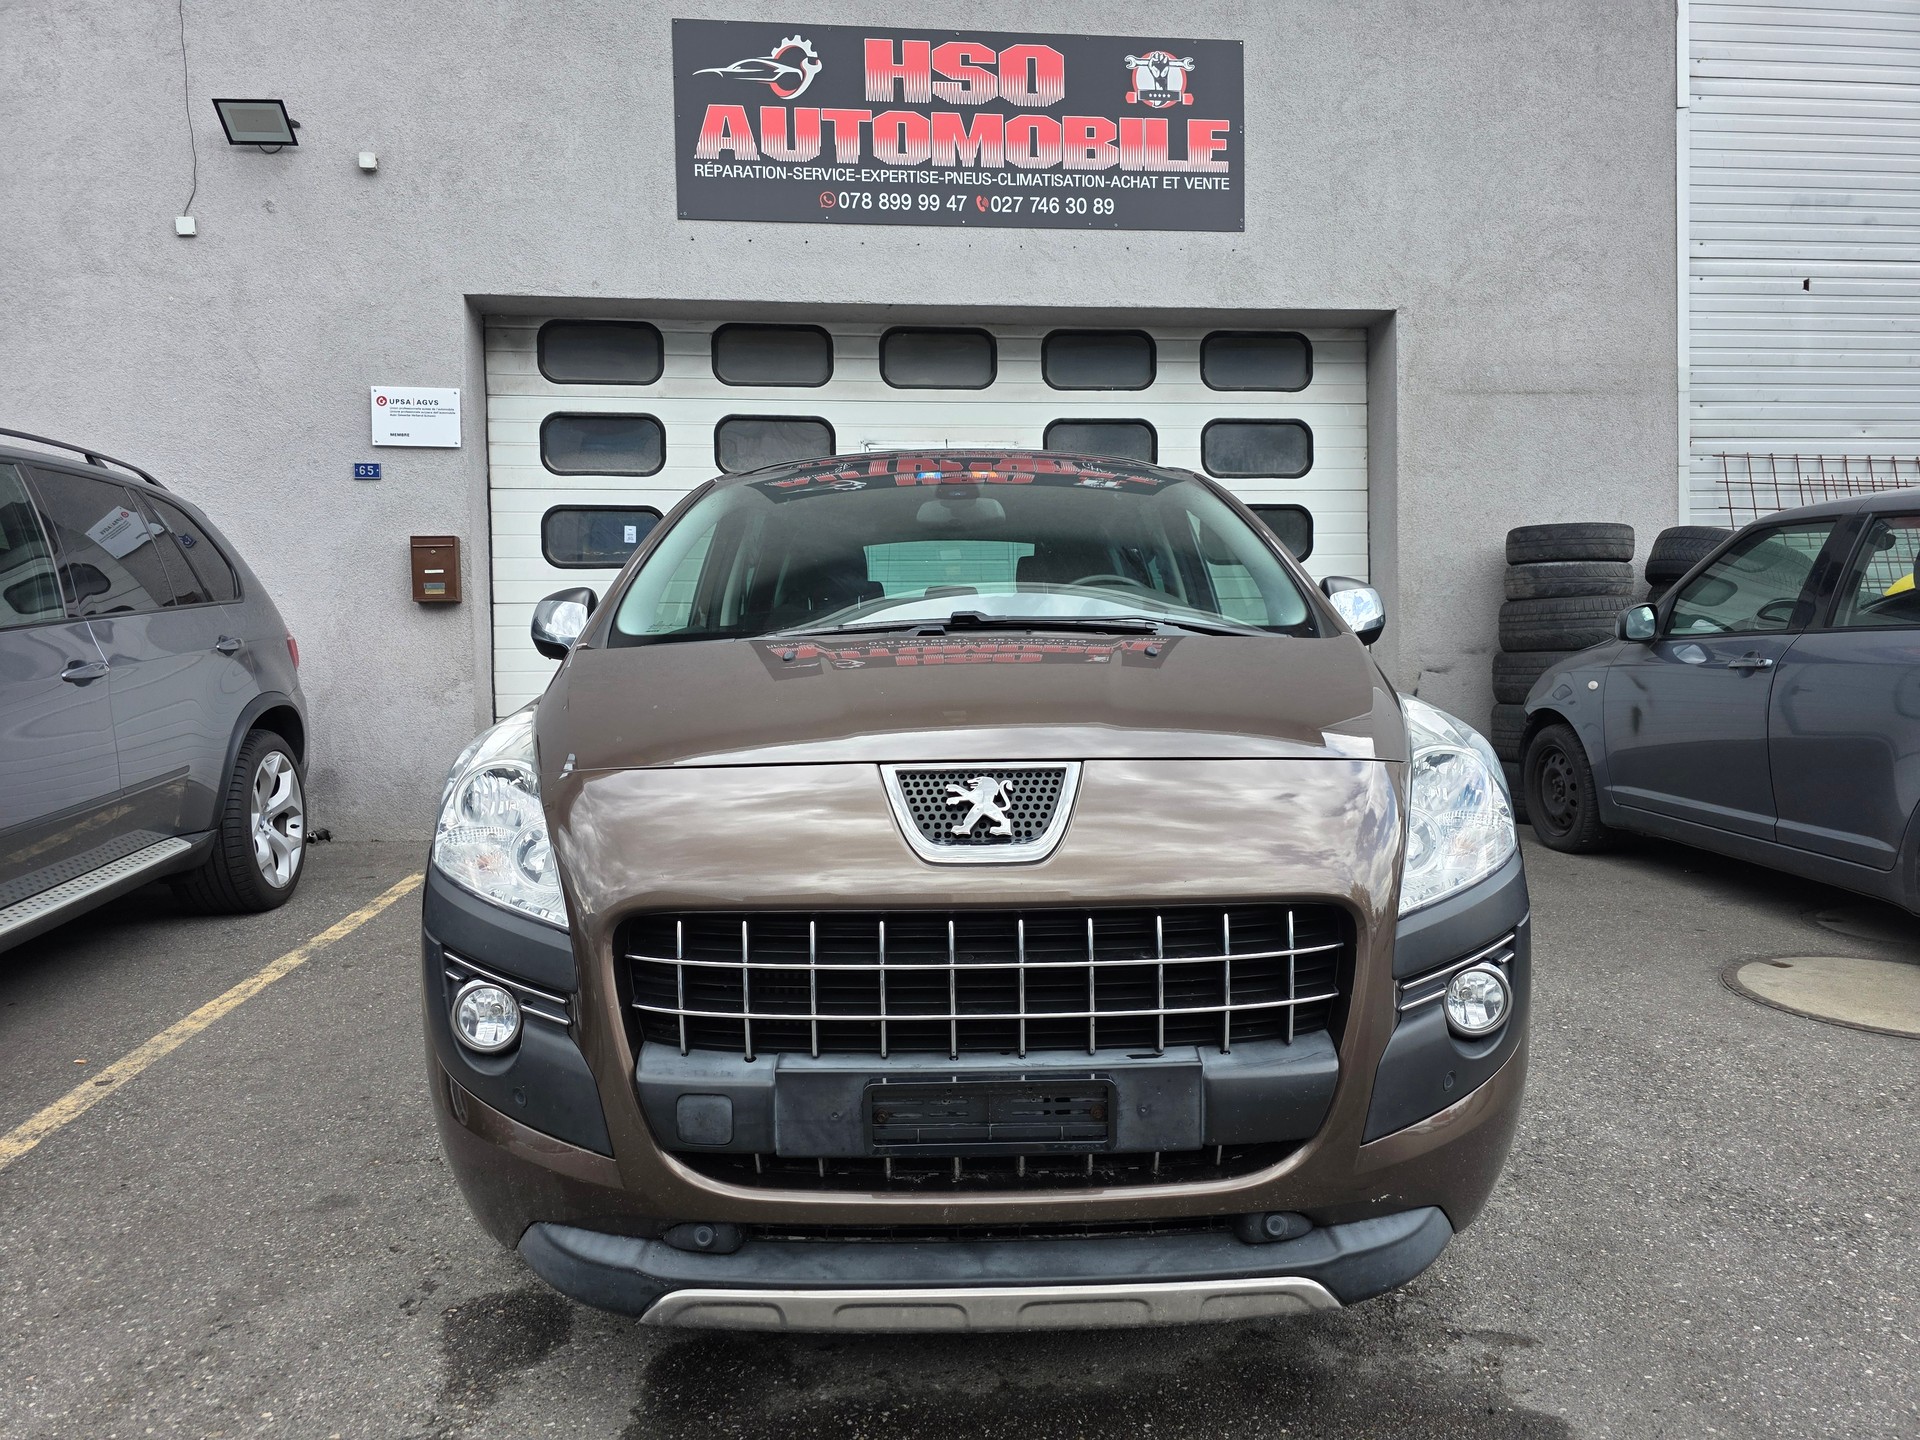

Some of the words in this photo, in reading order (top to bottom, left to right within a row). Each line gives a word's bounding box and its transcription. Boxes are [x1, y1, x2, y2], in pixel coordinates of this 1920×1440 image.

[864, 37, 1065, 107] HSO
[694, 103, 1230, 174] AUTOMOBILE
[1163, 176, 1181, 189] ET
[1185, 177, 1230, 190] VENTE
[838, 191, 873, 209] 078
[878, 192, 912, 210] 899
[918, 193, 941, 211] 99
[946, 194, 968, 212] 47
[990, 195, 1024, 213] 027
[1029, 196, 1060, 214] 746
[1065, 197, 1087, 214] 30
[1093, 198, 1115, 215] 89
[359, 465, 374, 475] 65
